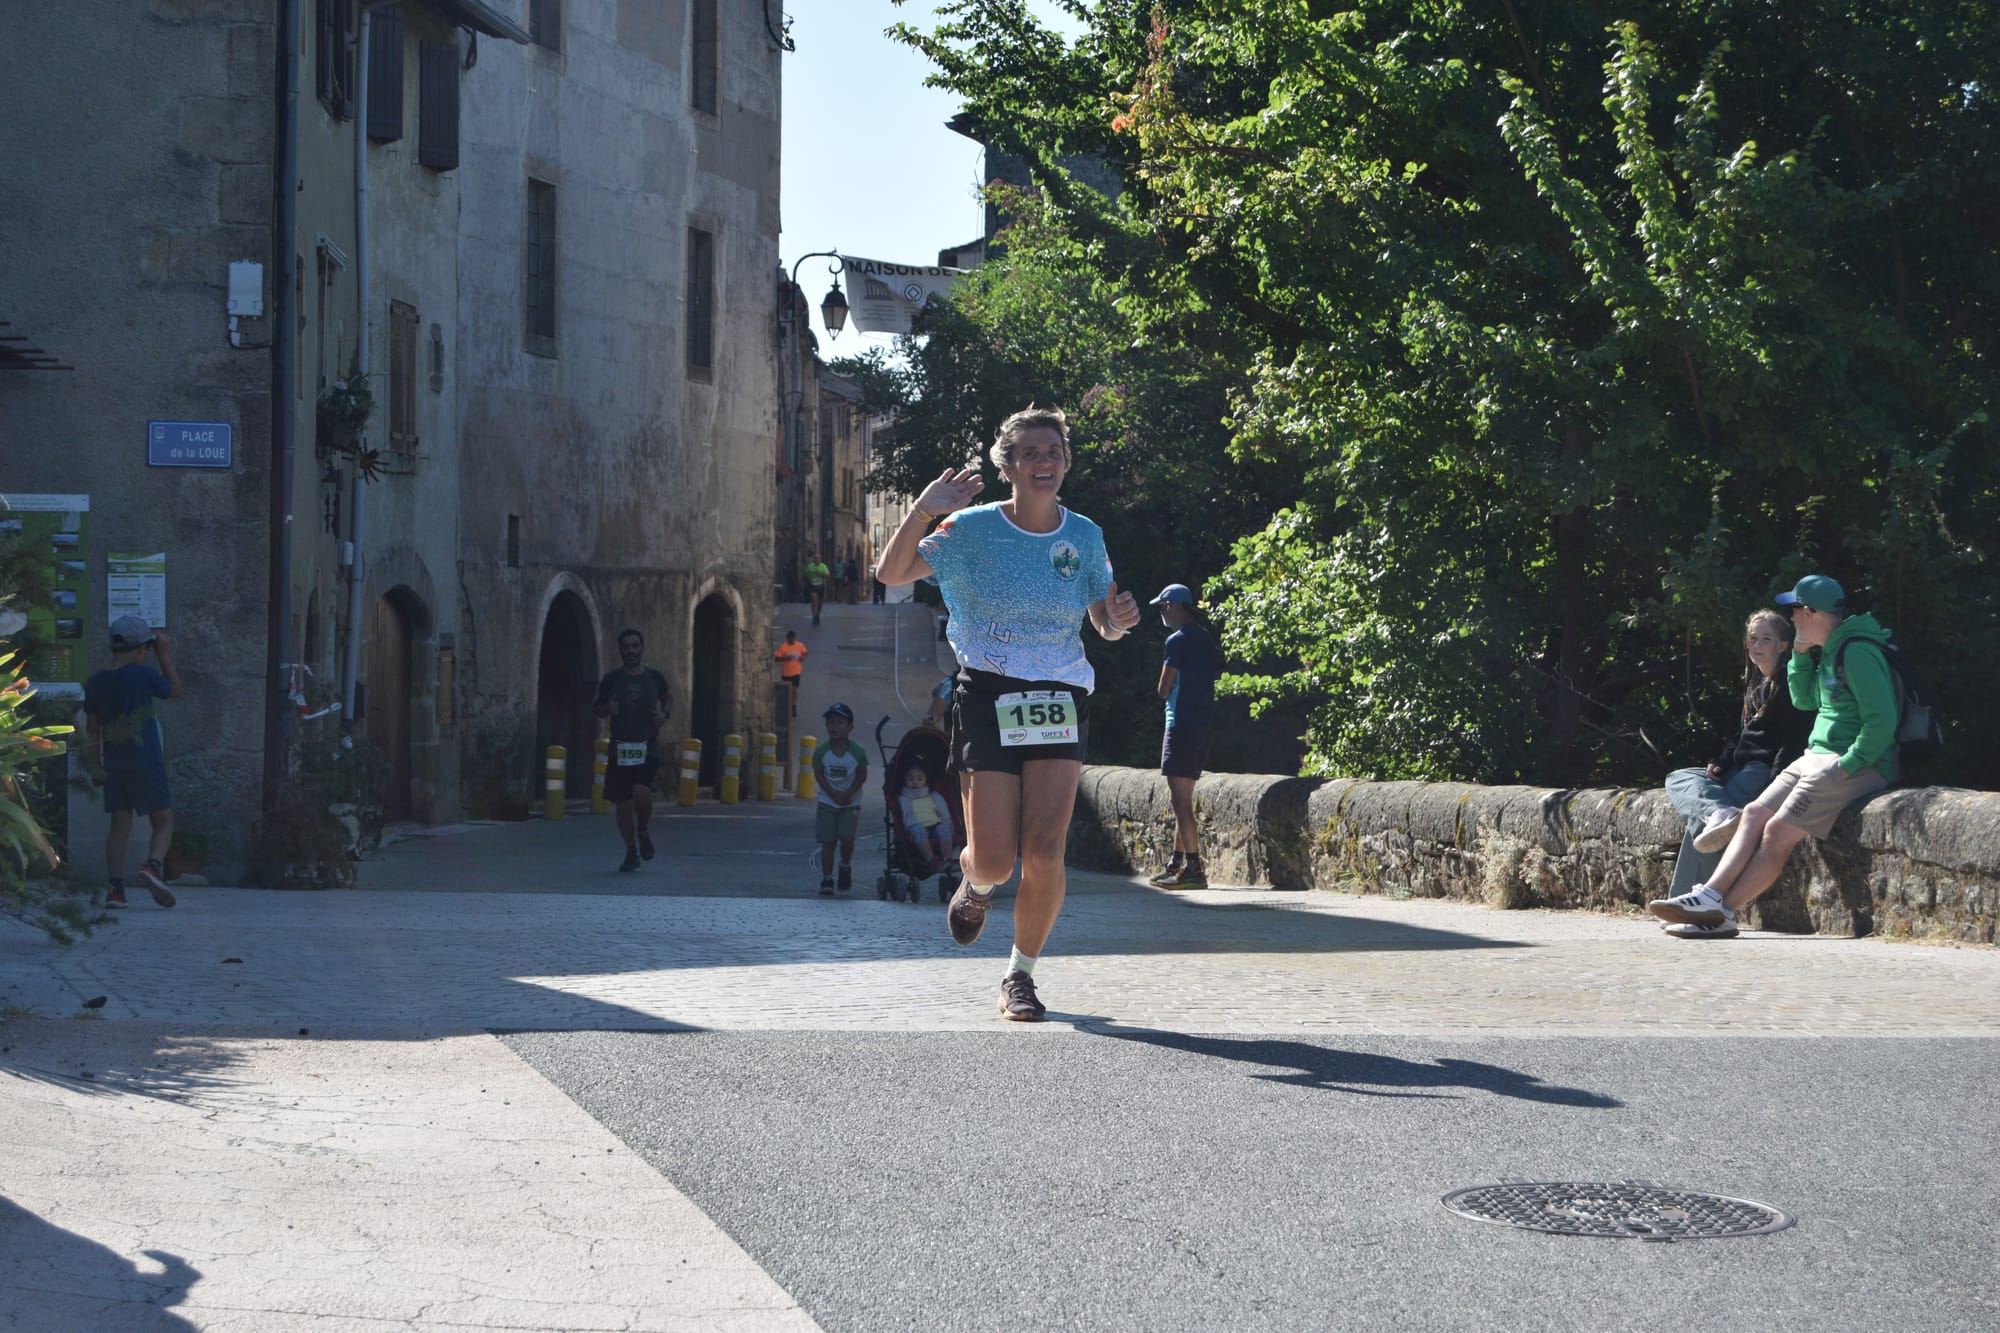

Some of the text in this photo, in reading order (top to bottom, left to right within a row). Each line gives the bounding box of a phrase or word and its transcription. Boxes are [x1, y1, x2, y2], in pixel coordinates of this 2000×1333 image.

[849, 261, 923, 276] MAISON
[928, 267, 952, 276] DE
[182, 431, 214, 442] PLACE
[170, 448, 225, 458] de la LOUE
[1010, 703, 1066, 726] 158
[621, 749, 642, 759] 159
